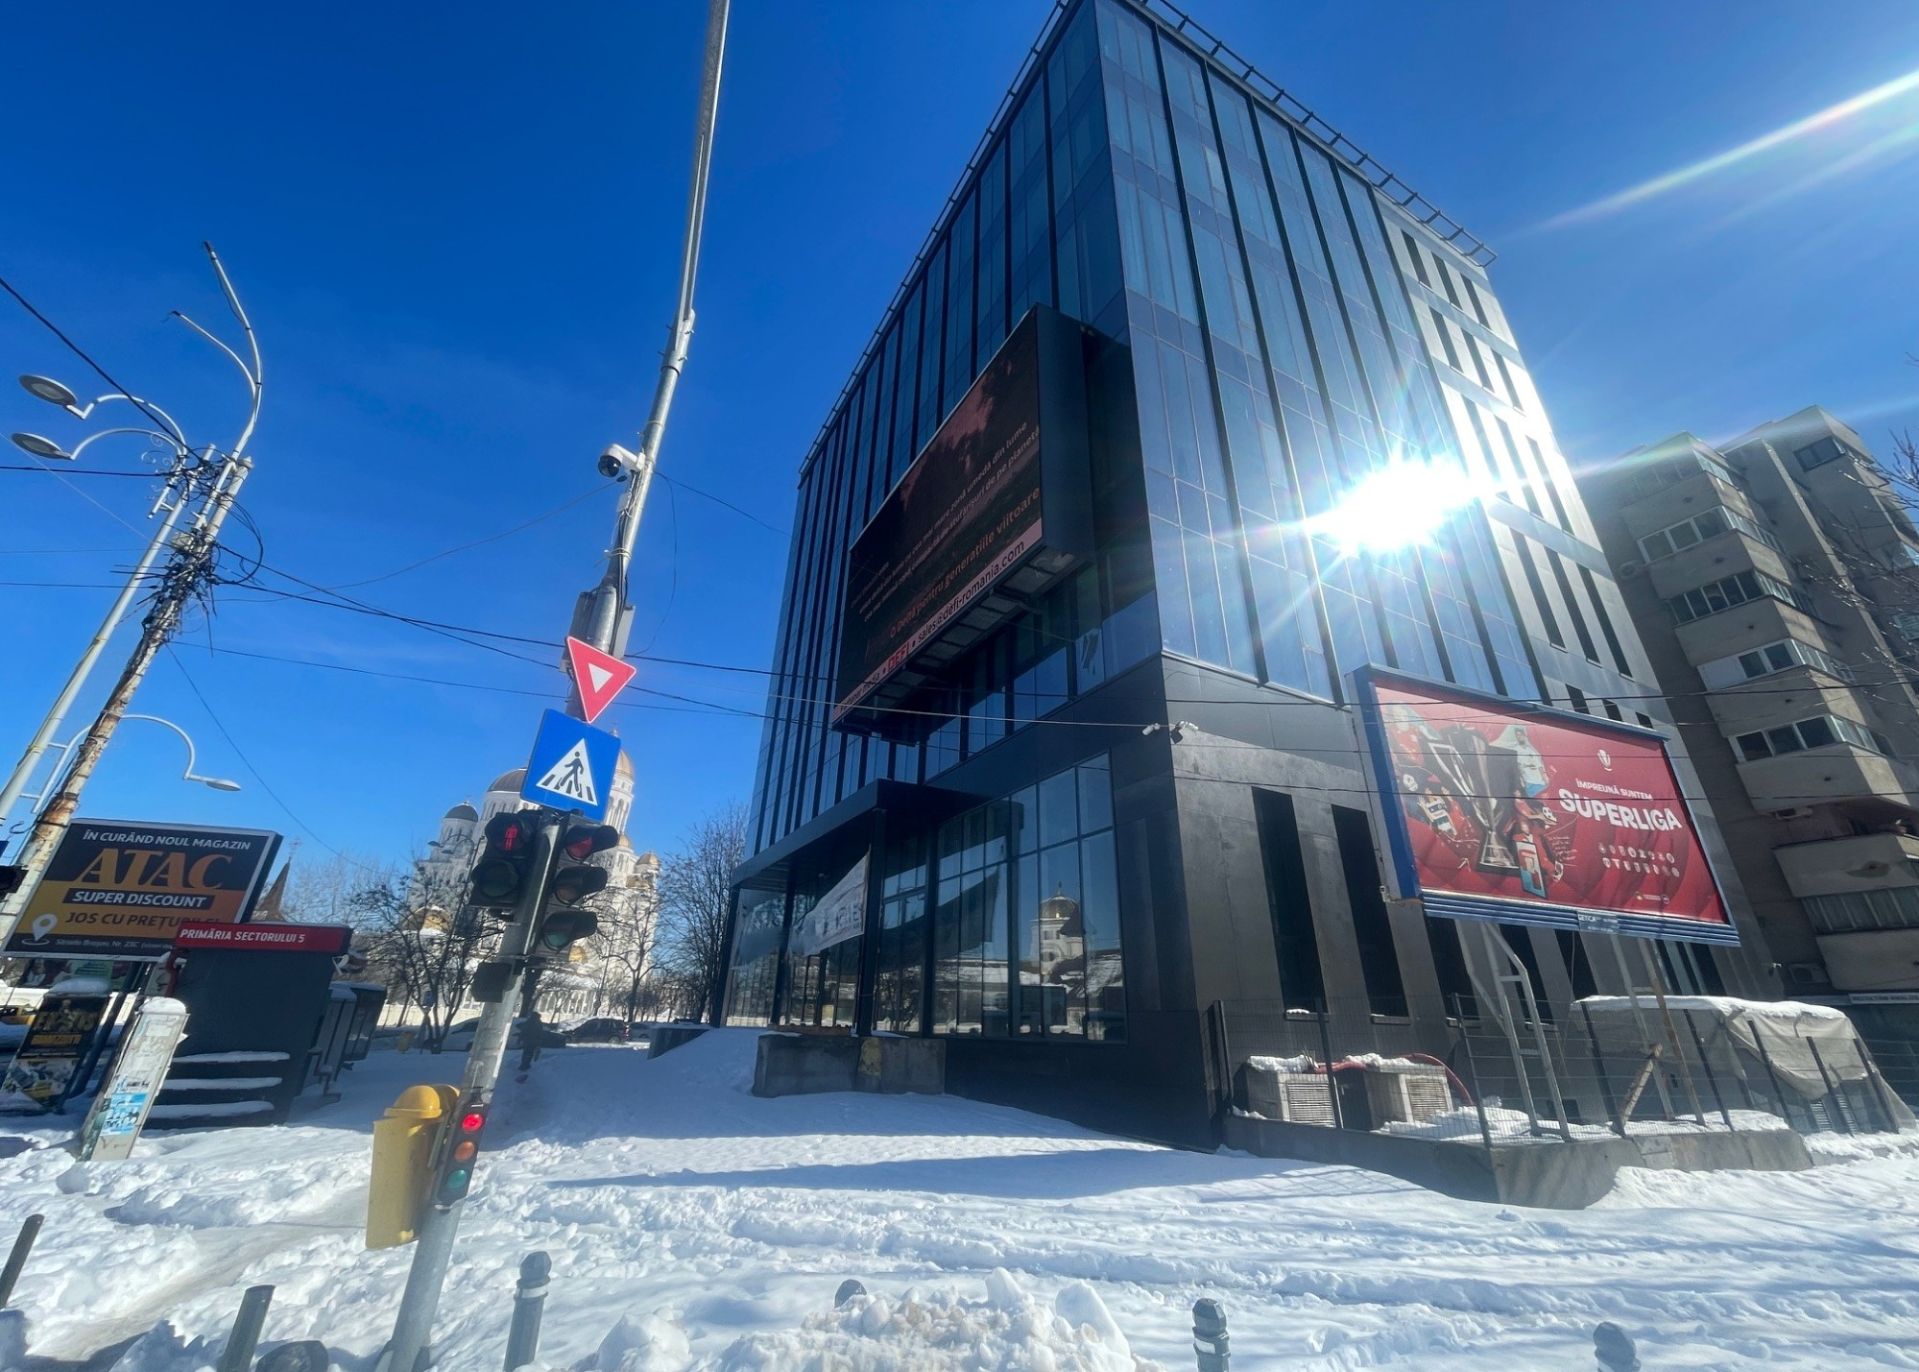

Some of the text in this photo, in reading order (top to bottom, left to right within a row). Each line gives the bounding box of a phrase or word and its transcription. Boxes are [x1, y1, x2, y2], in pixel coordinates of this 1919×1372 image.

[1006, 419, 1027, 450] lume
[996, 484, 1040, 537] viitoare
[1576, 779, 1653, 800] ÎMPREUNĂ SUNTEM
[1558, 788, 1682, 831] SUPERLIGA
[82, 830, 251, 850] ÎN CURÂND NOUL MAGAZIN
[72, 848, 232, 889] ATAC
[72, 891, 207, 908] SUPER DISCOUNT
[66, 912, 98, 924] JOS
[101, 914, 126, 925] CU
[180, 928, 306, 943] PRIMĂRIA SECTORULUI 5
